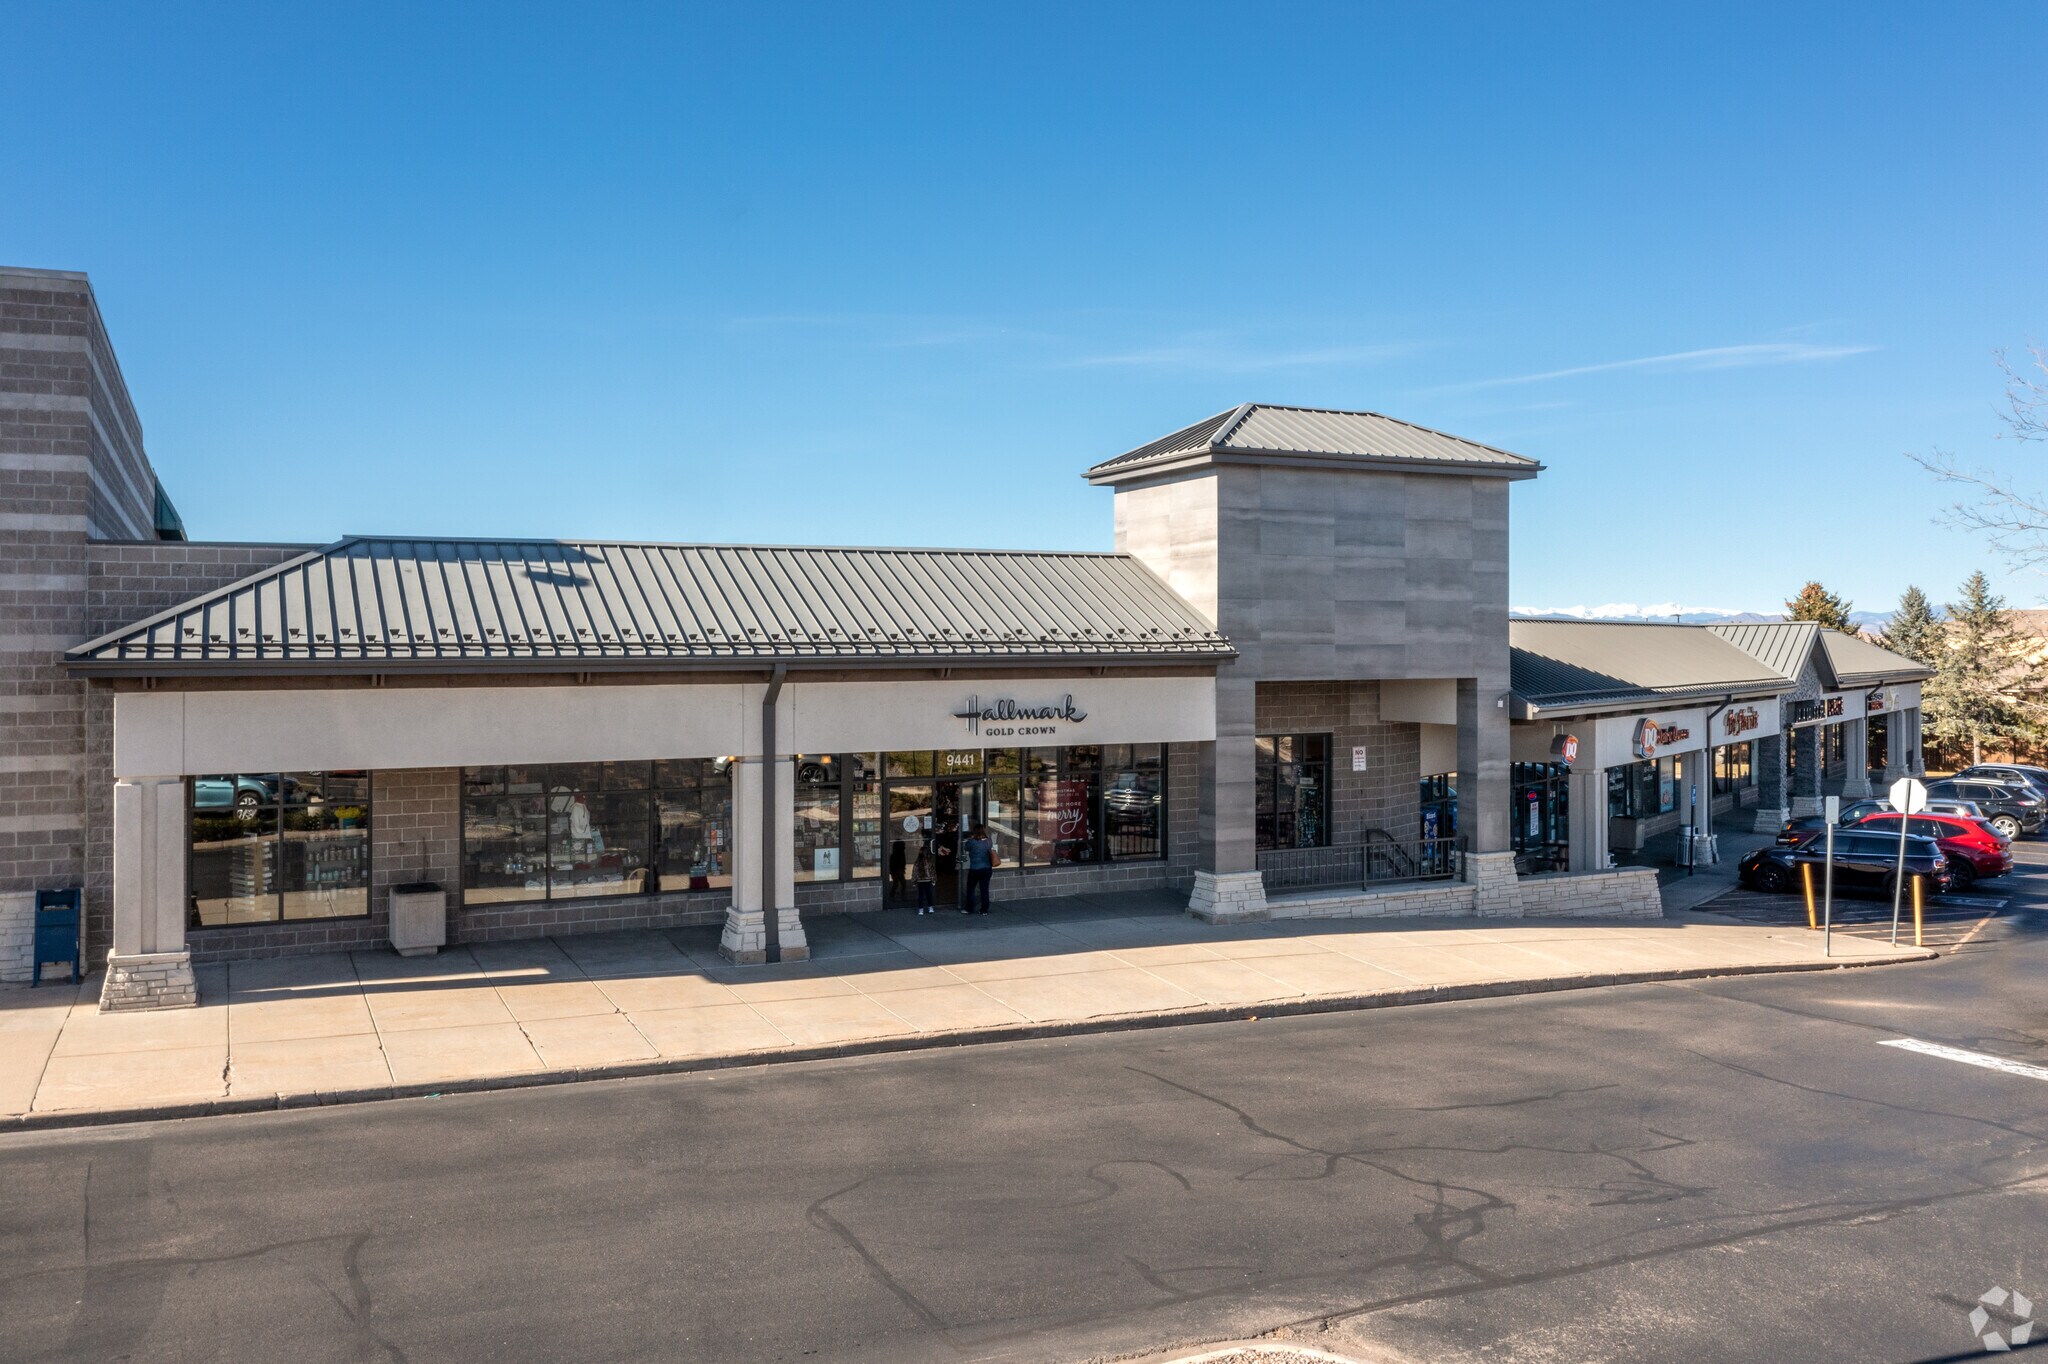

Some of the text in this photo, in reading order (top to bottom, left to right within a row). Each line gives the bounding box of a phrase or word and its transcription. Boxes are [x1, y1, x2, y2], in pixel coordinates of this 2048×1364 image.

[953, 694, 1087, 736] Hallmark
[986, 726, 1056, 736] GOLD CROWN
[1645, 727, 1656, 748] DQ
[946, 754, 974, 766] 9441
[1566, 742, 1577, 759] DQ
[1047, 808, 1083, 834] merry
